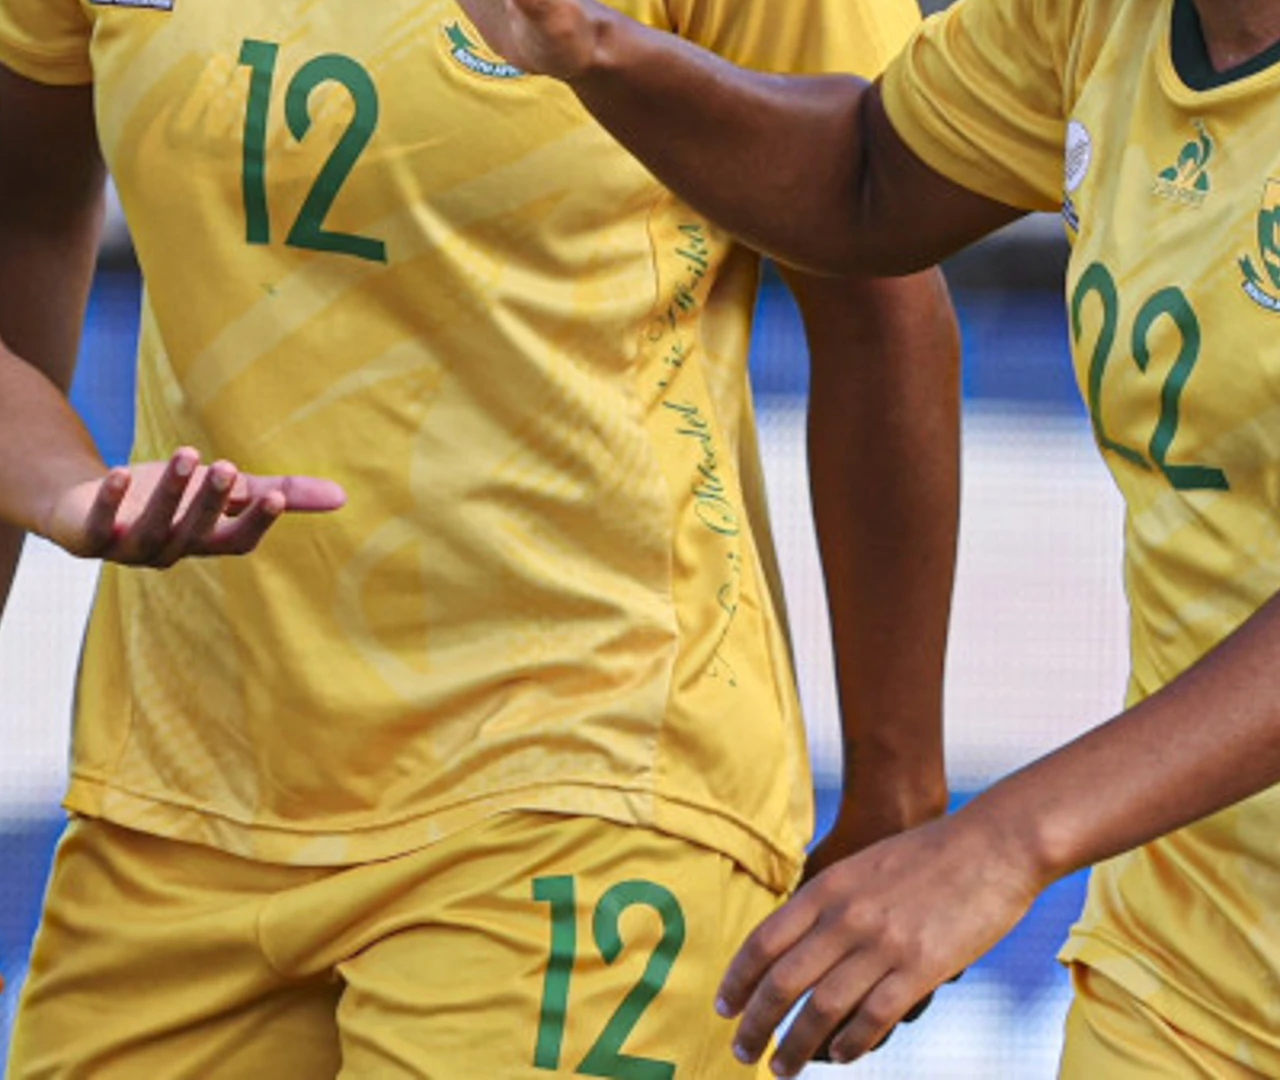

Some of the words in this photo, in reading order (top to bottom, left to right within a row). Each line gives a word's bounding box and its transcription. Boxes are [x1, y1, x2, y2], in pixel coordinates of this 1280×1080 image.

[238, 38, 388, 263] 12
[1072, 262, 1230, 491] 22
[532, 874, 686, 1080] 12
